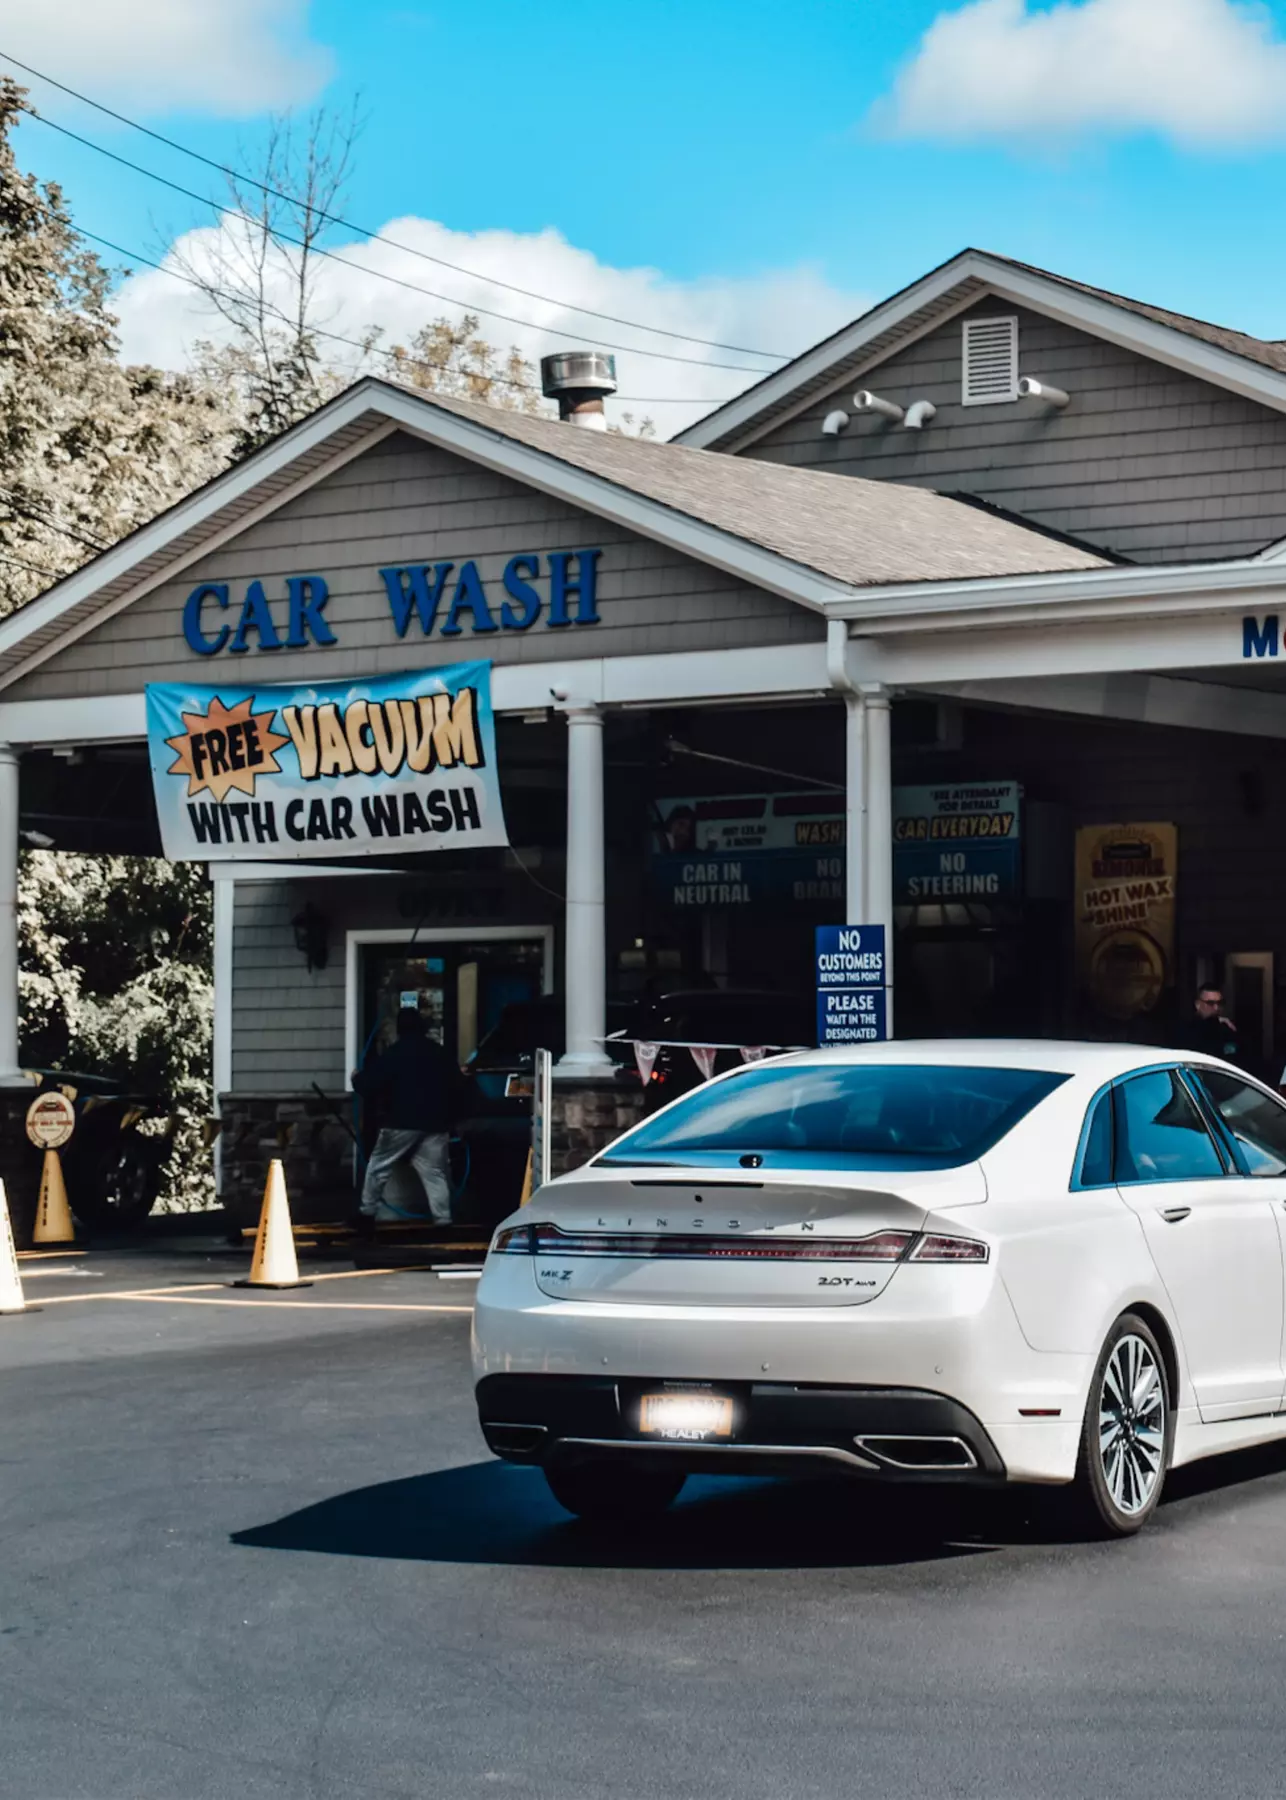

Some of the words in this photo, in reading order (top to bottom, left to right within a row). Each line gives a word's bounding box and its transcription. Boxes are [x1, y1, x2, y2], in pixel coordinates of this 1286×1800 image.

[183, 576, 338, 656] CAR
[379, 549, 602, 639] WASH
[189, 719, 265, 781] FREE
[281, 687, 486, 781] VACUUM
[186, 801, 279, 844] WITH
[285, 796, 357, 841] CAR
[361, 787, 481, 838] WASH
[796, 821, 844, 845] WASH
[895, 816, 928, 841] CAR
[930, 812, 1014, 839] EVERYDAY
[682, 863, 719, 883] CAR
[723, 861, 742, 882] IN
[815, 857, 841, 878] NO
[939, 852, 966, 874] NO
[674, 884, 752, 905] NEUTRAL
[908, 873, 999, 896] STEERING
[1086, 888, 1120, 908] HOT
[1126, 880, 1170, 901] WAX
[1095, 903, 1146, 925] SHINE
[839, 929, 861, 951] NO
[818, 953, 883, 971] CUSTOMERS
[820, 972, 845, 982] BEYOND
[846, 972, 860, 982] THIS
[861, 972, 881, 981] POINT
[827, 995, 874, 1011] PLEASE
[826, 1014, 847, 1025] WAIT
[848, 1014, 858, 1024] IN
[860, 1013, 877, 1024] THE
[825, 1028, 878, 1040] DESIGNATED
[597, 1218, 814, 1231] LINCOLN
[661, 1429, 707, 1440] HEALEY
